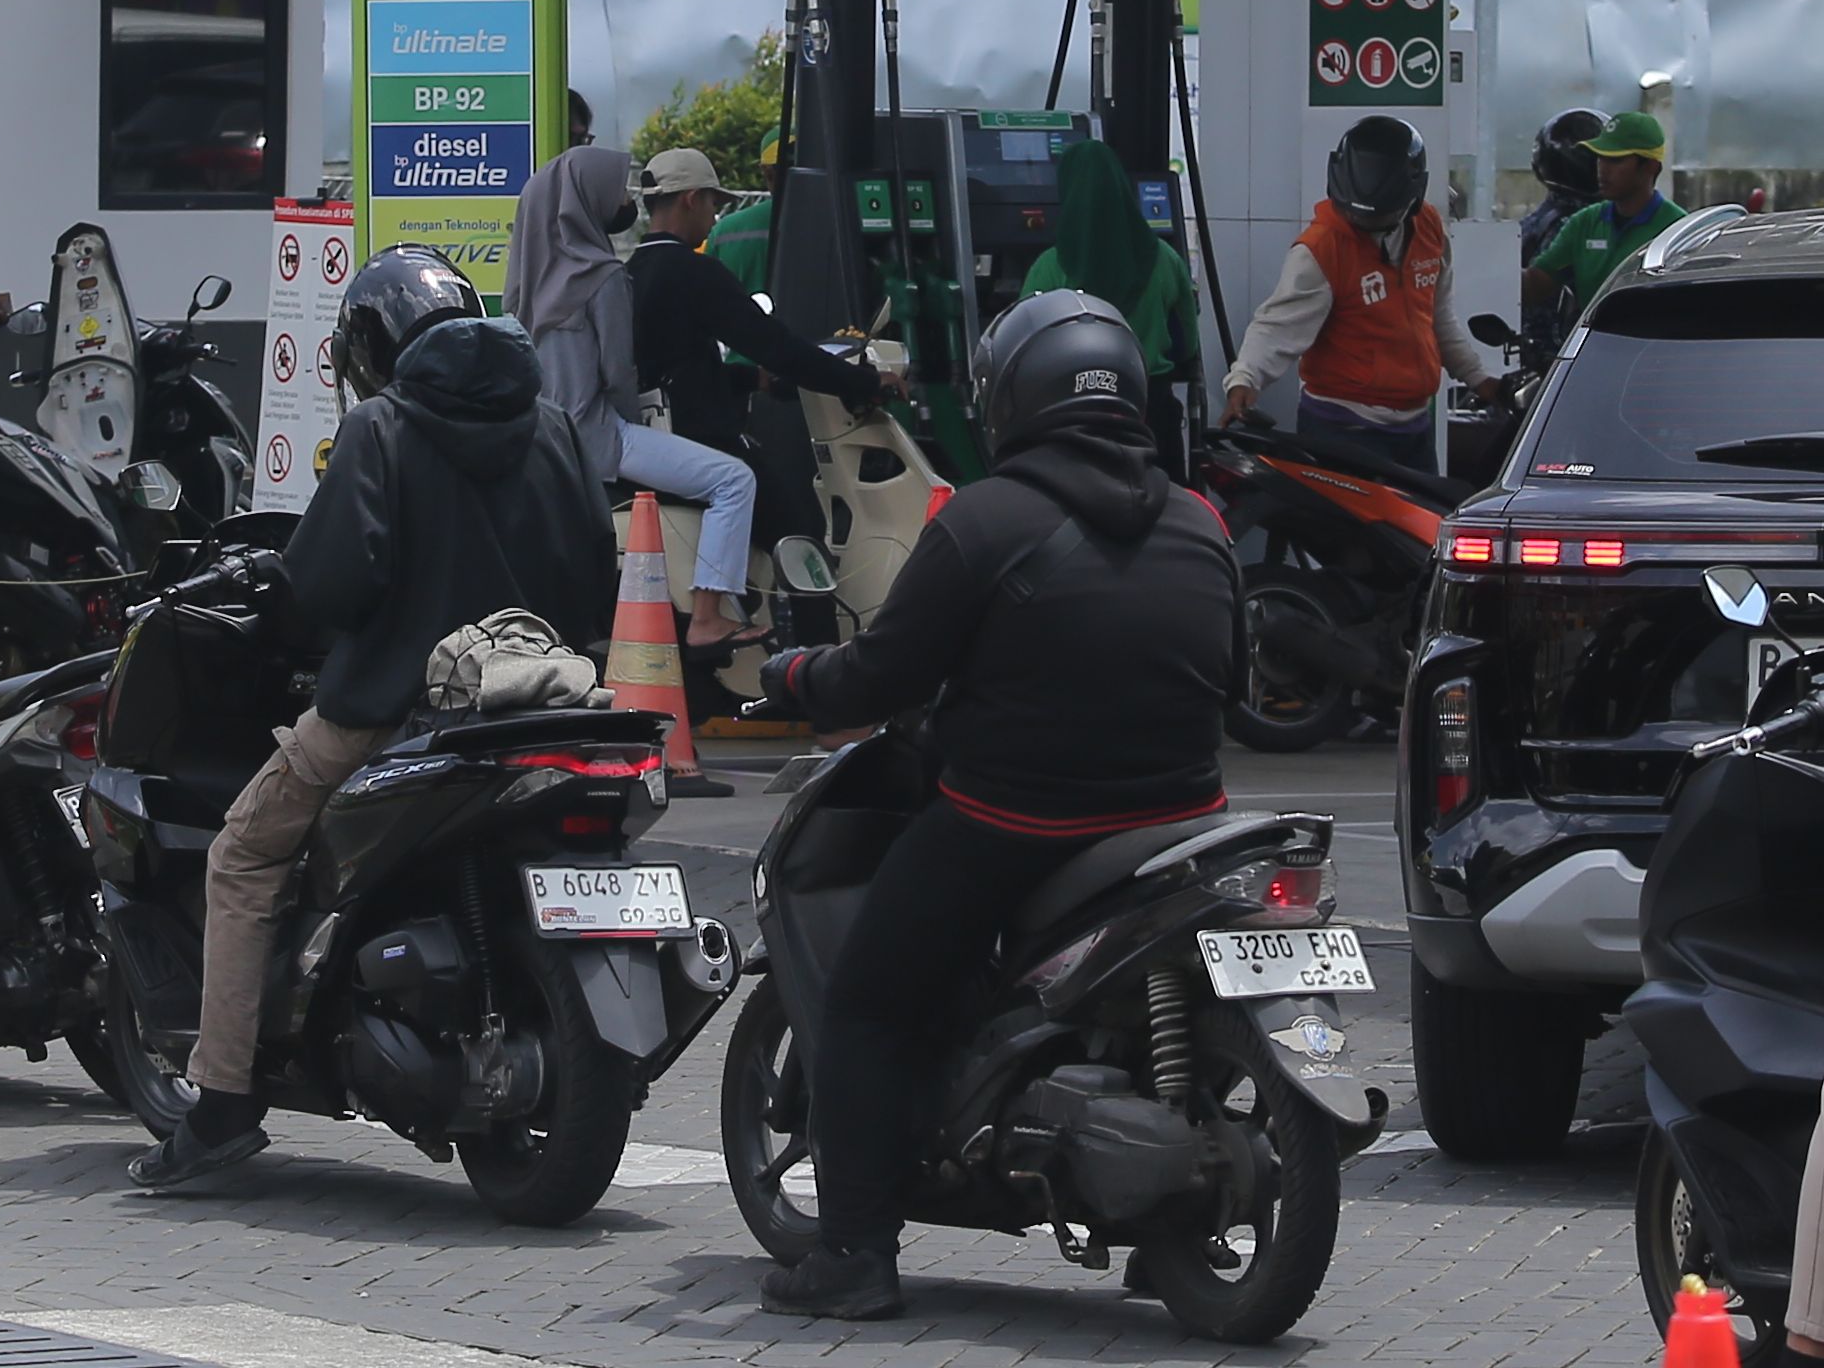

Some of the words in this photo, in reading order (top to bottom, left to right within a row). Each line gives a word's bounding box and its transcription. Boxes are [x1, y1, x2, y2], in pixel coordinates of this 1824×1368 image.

[393, 22, 407, 35] bp
[393, 29, 507, 53] ultimate
[415, 87, 447, 111] BP
[455, 87, 485, 111] 92
[413, 133, 487, 158] diesel
[394, 155, 409, 169] bp
[393, 161, 508, 187] ultimate
[399, 220, 441, 234] dengan
[444, 220, 500, 234] Teknologi
[434, 244, 506, 263] TIVE
[1075, 370, 1118, 393] FUZZ
[1567, 464, 1593, 473] AUTO
[1285, 851, 1322, 864] YAMAHA
[532, 873, 547, 897] B
[564, 872, 621, 897] 6048
[634, 872, 678, 896] ZYI
[1205, 938, 1223, 964] B
[1230, 934, 1294, 961] 3200
[1308, 932, 1358, 958] EWO
